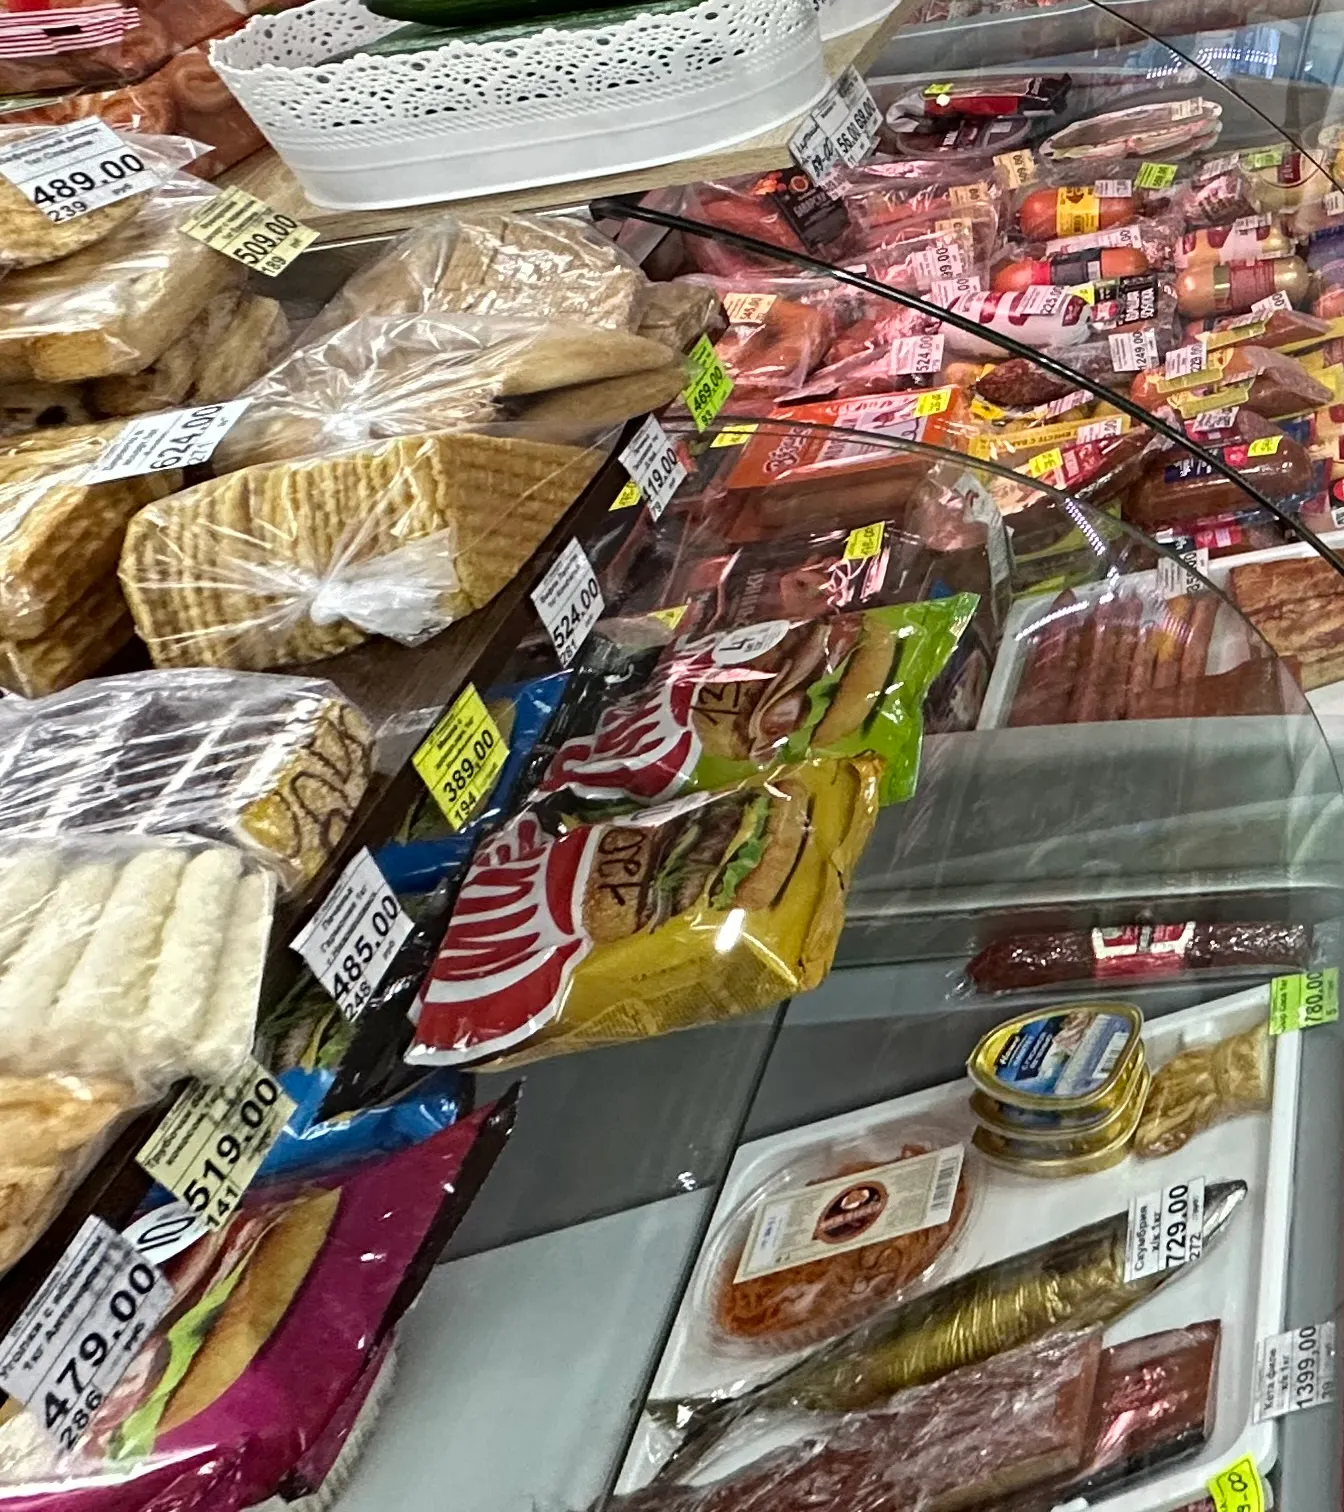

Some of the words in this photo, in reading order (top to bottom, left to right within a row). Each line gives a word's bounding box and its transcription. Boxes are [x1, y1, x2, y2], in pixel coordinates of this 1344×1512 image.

[33, 153, 146, 207] 489.00
[48, 199, 89, 223] 239
[232, 213, 299, 267] 509.00
[692, 364, 724, 413] 469.00
[150, 404, 225, 470] 624.00
[551, 576, 599, 650] 524.00
[442, 729, 495, 803] 389.00
[332, 894, 398, 1002] 485.00
[343, 980, 371, 1022] 248
[183, 1077, 279, 1213] 519.00
[206, 1186, 240, 1229] 141
[1165, 1184, 1190, 1267] 729.00
[43, 1262, 156, 1430] 479.00
